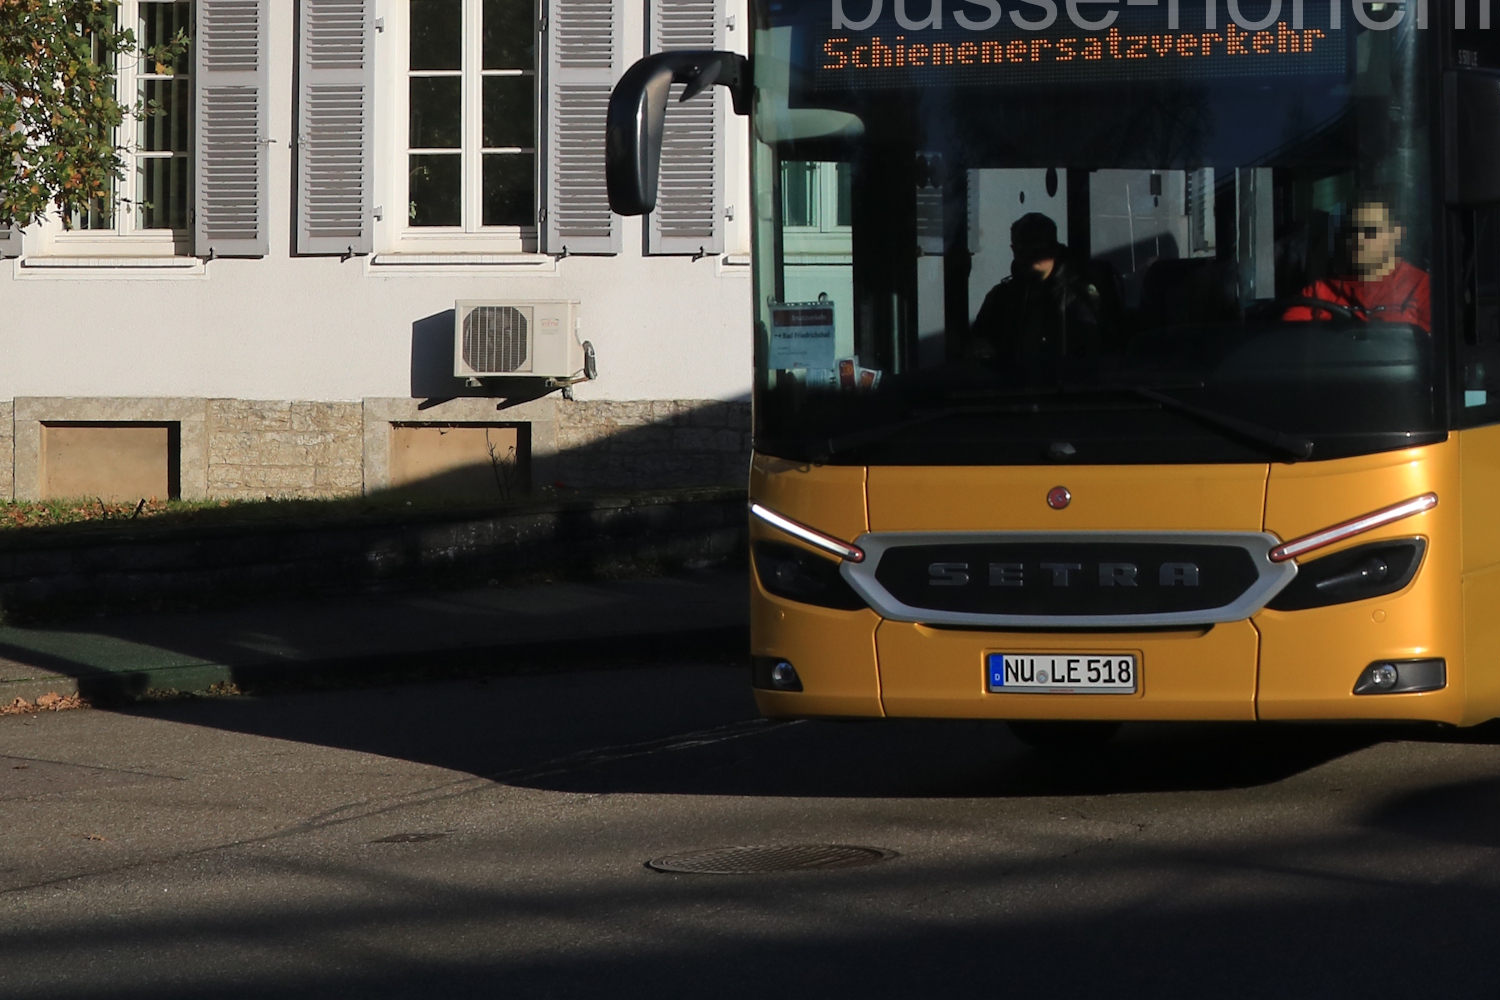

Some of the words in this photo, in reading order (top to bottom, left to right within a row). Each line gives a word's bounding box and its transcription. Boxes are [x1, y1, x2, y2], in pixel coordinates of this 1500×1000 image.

[822, 21, 1326, 69] Schienenersatzverkehr
[928, 562, 1200, 587] SETRA
[1005, 659, 1034, 683] NU
[1051, 659, 1081, 683] LE
[1087, 659, 1131, 683] 518
